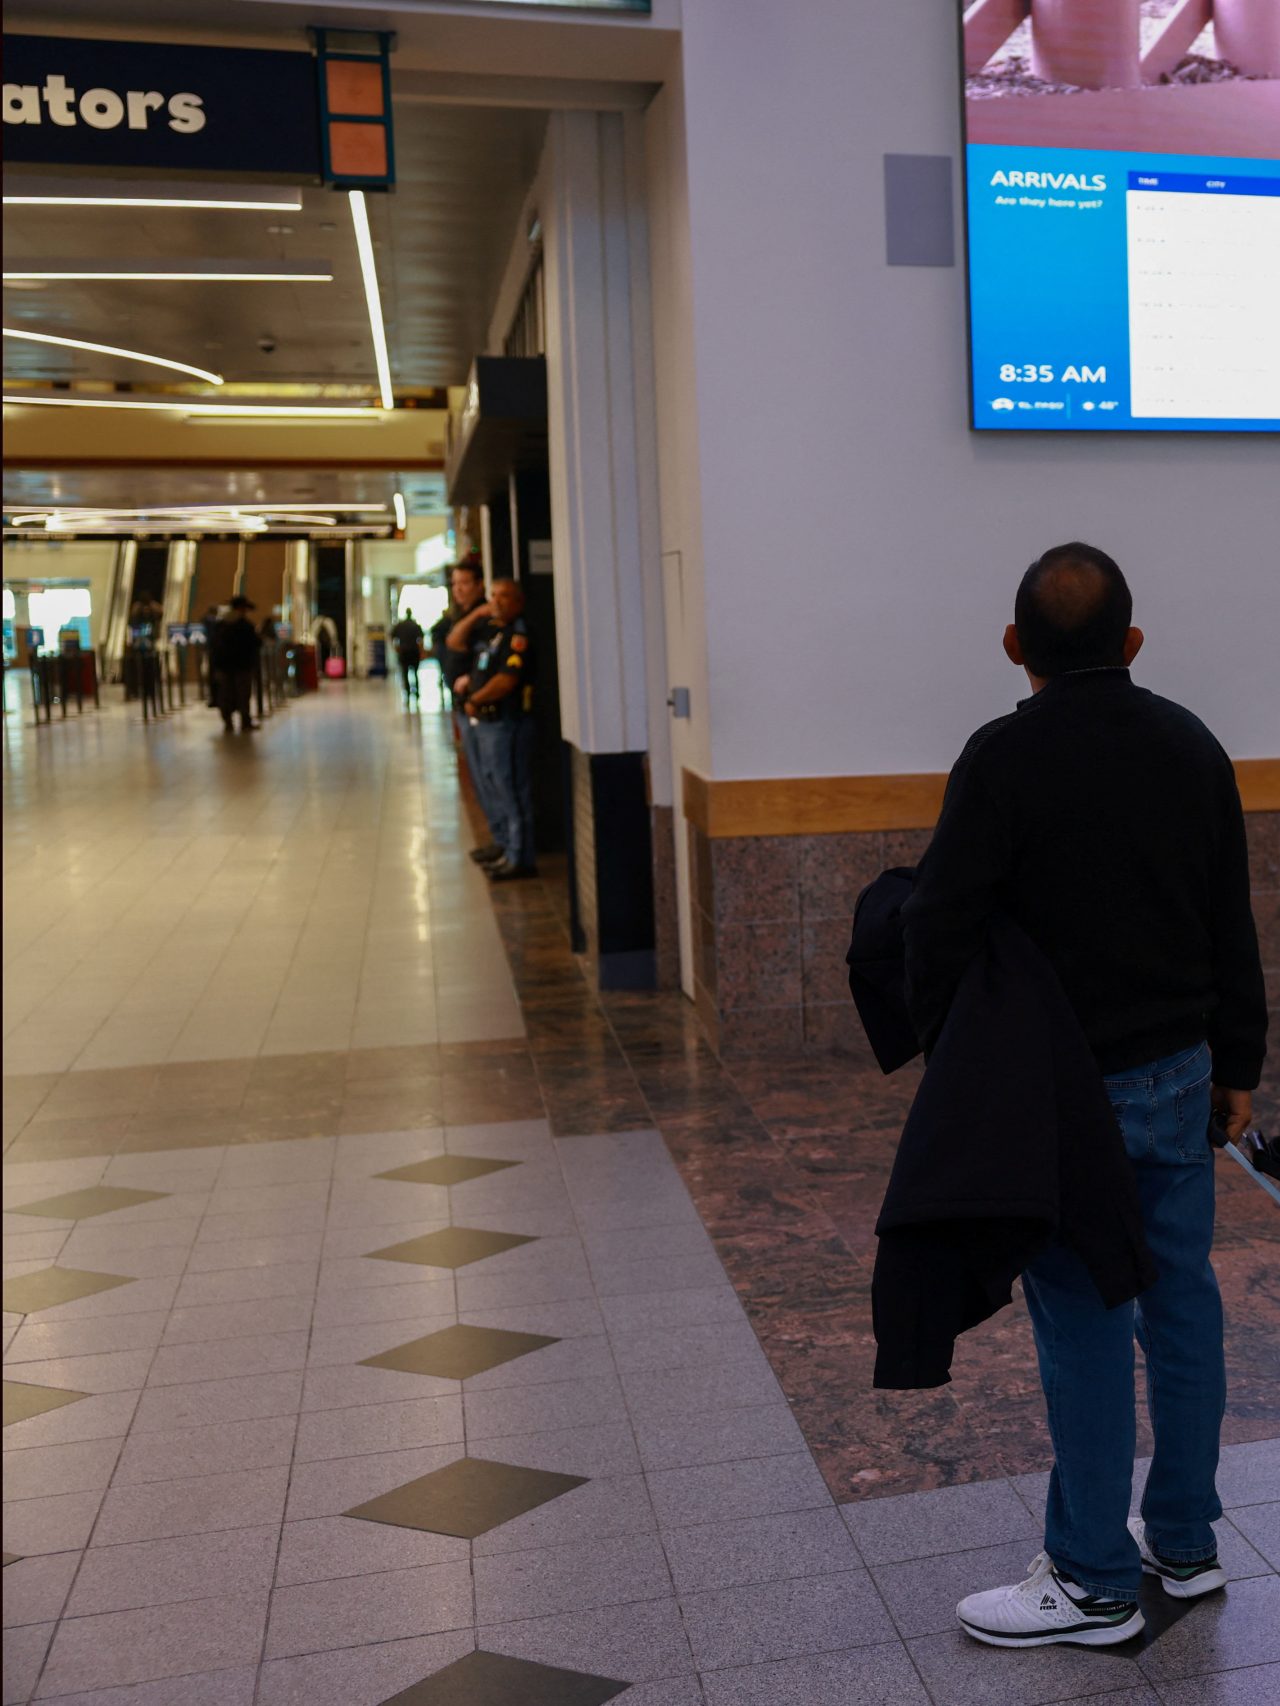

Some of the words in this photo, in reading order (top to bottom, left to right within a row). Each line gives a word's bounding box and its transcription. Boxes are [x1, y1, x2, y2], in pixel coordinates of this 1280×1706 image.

[991, 170, 1107, 192] ARRIVALS
[995, 195, 1017, 206] Are
[1019, 196, 1046, 208] they
[1048, 198, 1075, 208] here
[1078, 199, 1103, 209] yet?
[1000, 363, 1054, 383] 8:35
[1061, 365, 1107, 383] AM
